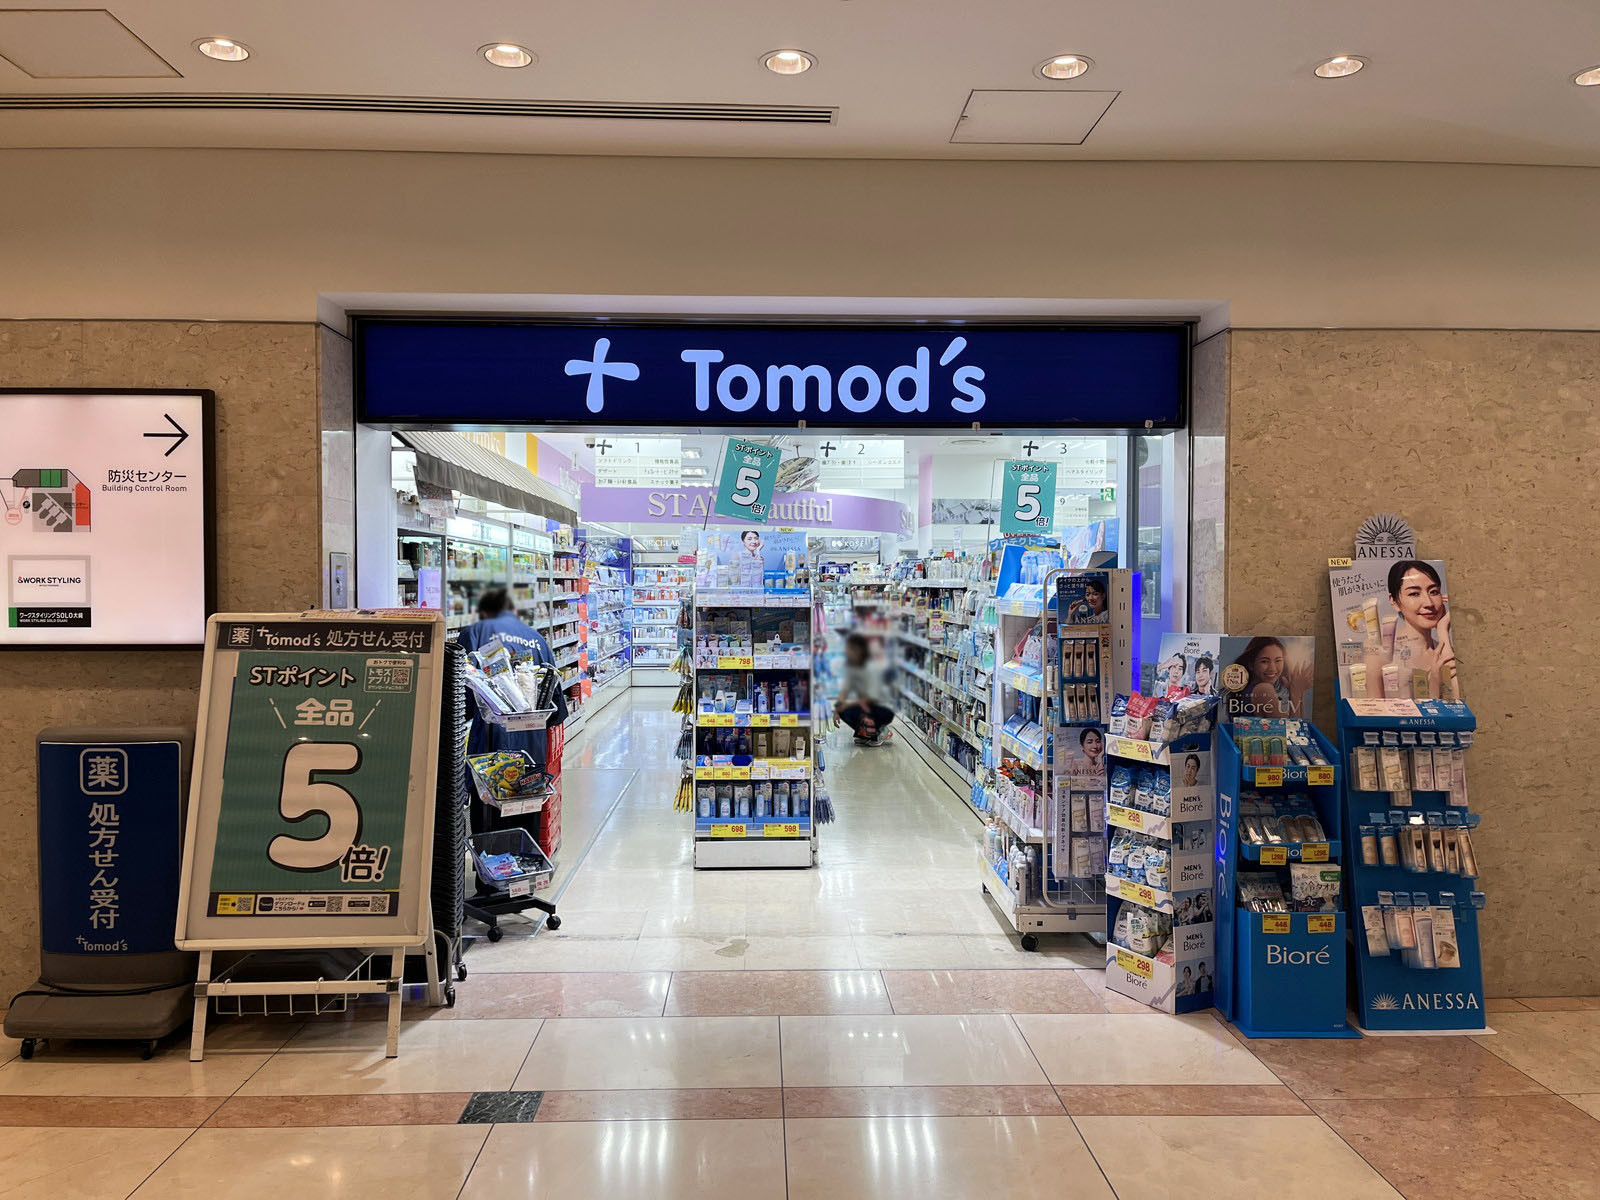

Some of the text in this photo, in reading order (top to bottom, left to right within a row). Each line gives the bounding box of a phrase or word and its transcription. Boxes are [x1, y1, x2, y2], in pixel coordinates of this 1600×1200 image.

[681, 336, 986, 413] Tomod's
[735, 443, 773, 459] STポイント
[858, 443, 865, 455] 2
[1059, 442, 1067, 455] 3
[743, 454, 761, 467] 全品
[1011, 464, 1049, 473] STポイント
[108, 469, 187, 483] 防災センター
[1020, 472, 1039, 482] 全品
[102, 484, 188, 493] Building Control Room
[731, 466, 761, 506] 5
[1014, 484, 1041, 521] 5
[1357, 546, 1414, 558] ANESSA
[232, 627, 425, 648] 薬 Tomod's 処方せん受付
[250, 666, 356, 688] STポイント
[369, 668, 392, 676] トモズ
[368, 676, 391, 685] アプリ
[294, 697, 355, 727] 全品
[1229, 698, 1302, 714] Bioré UV
[1409, 718, 1436, 726] ANESSA
[88, 756, 119, 788] 薬
[521, 772, 542, 785] HARIBO
[1072, 768, 1097, 776] ANESSA
[267, 741, 363, 873] 5
[1180, 801, 1203, 813] Bioré
[731, 825, 744, 833] 698
[1218, 793, 1232, 898] Bioré
[88, 802, 120, 930] 処方せん受付
[340, 845, 390, 882] 倍!
[1180, 870, 1204, 882] Bioré
[82, 939, 129, 952] Tomod's
[1183, 940, 1206, 951] Bioré
[1266, 944, 1330, 965] Bioré
[1126, 972, 1148, 989] Bioré
[1402, 992, 1479, 1011] ANESSA
